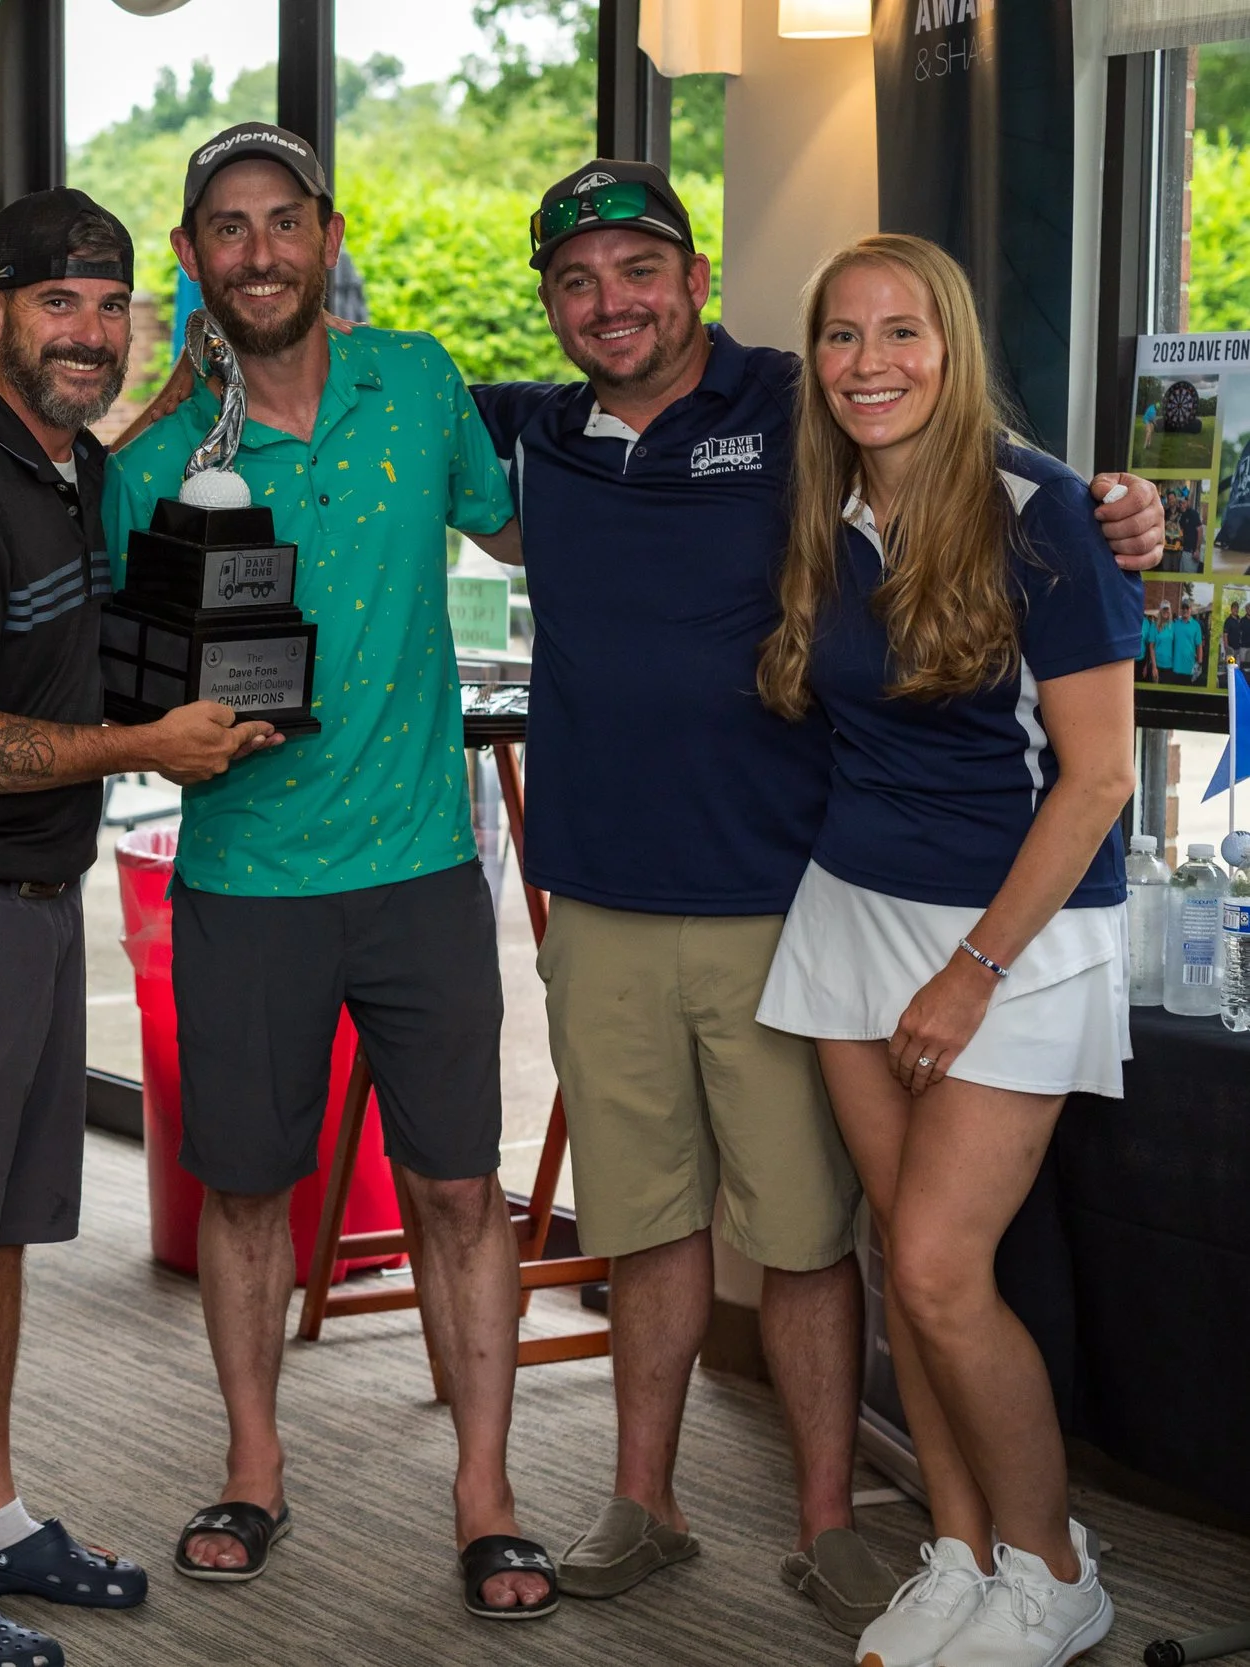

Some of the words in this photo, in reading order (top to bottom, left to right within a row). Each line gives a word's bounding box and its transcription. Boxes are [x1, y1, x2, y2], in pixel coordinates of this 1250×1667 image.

[197, 132, 307, 165] TaylorMade
[1153, 341, 1186, 363] 2023
[1188, 340, 1222, 362] DAVE
[719, 436, 753, 448] DAVE
[719, 444, 754, 456] FONS
[691, 466, 736, 478] MEMORIAL
[738, 463, 763, 471] FUND
[245, 558, 273, 568] DAVE
[244, 567, 272, 577] FONS
[246, 653, 264, 663] The
[228, 668, 253, 678] Dave
[254, 667, 279, 676] Fons
[210, 681, 243, 693] Annual
[244, 680, 263, 692] Golf
[264, 679, 294, 691] Outing
[217, 692, 285, 707] CHAMPIONS
